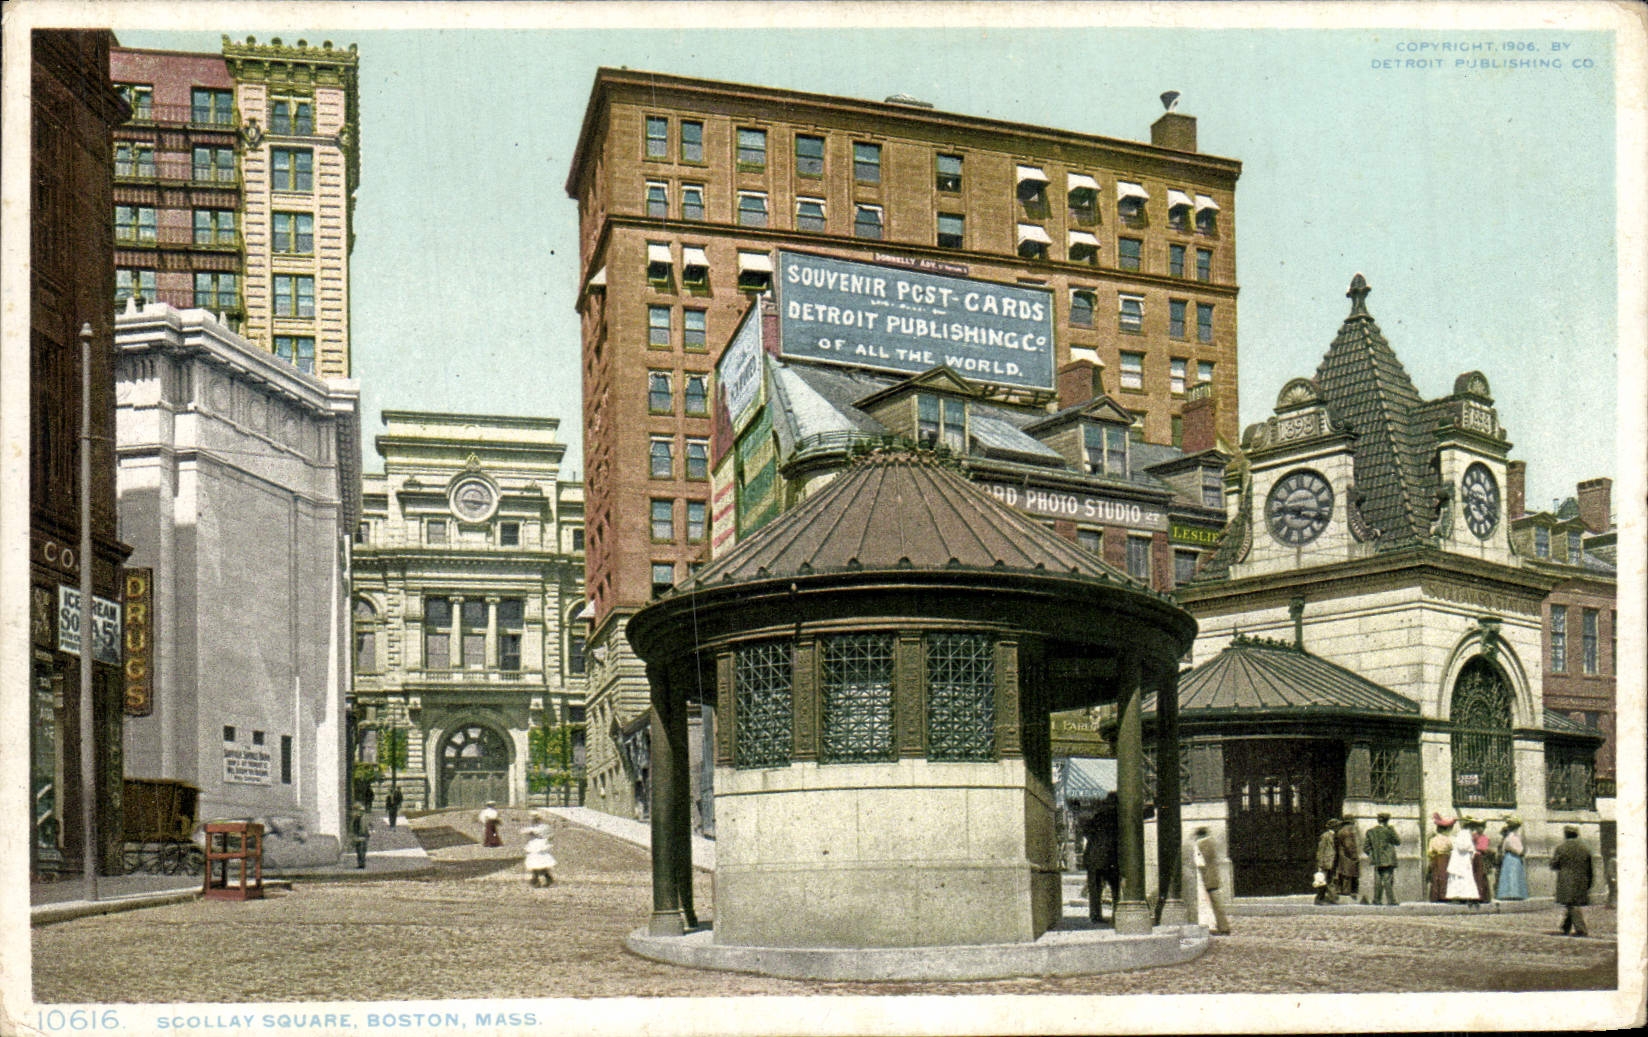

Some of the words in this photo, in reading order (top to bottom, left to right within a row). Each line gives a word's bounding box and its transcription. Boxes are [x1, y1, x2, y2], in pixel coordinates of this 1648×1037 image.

[787, 264, 887, 298] SOUVENIR
[788, 300, 879, 330] DETROIT
[886, 315, 1019, 350] PUBLISHING
[818, 338, 846, 351] OF
[855, 344, 890, 359] ALL
[896, 348, 936, 365] THE
[944, 354, 1024, 377] WORLD.
[1025, 489, 1078, 515] PHOTO
[1084, 498, 1141, 523] STUDIO
[64, 590, 81, 611] ICE
[60, 607, 99, 638] SOA
[125, 576, 146, 707] DRUGS
